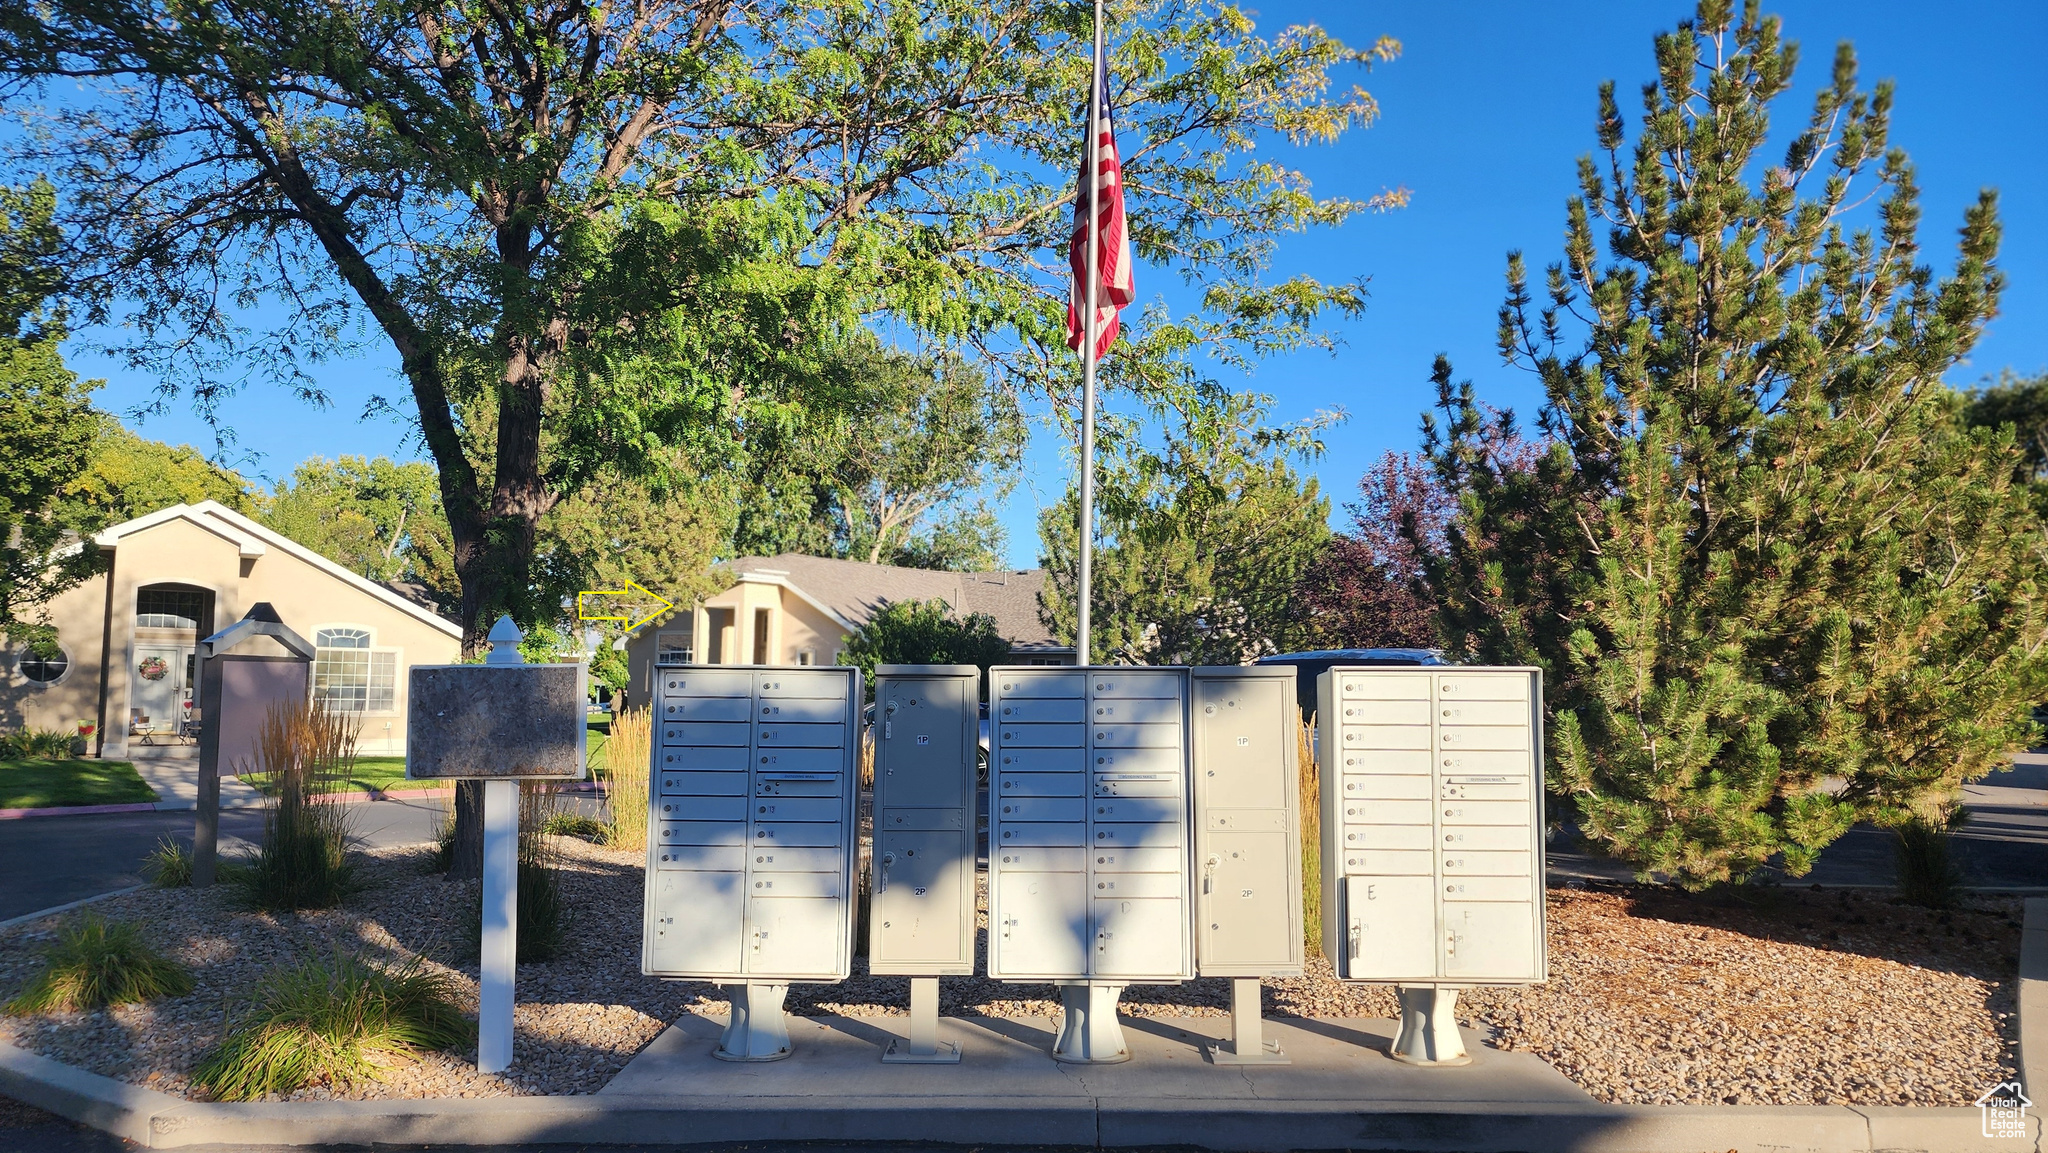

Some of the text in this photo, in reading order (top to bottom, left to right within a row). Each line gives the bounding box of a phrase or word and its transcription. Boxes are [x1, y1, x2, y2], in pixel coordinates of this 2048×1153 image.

[918, 736, 928, 744] 1P
[1238, 737, 1248, 745] 1P
[665, 878, 673, 891] A
[1028, 882, 1038, 895] C
[915, 888, 926, 896] 2P
[1242, 889, 1253, 898] 2P
[1367, 884, 1377, 900] E
[1121, 901, 1132, 914] D
